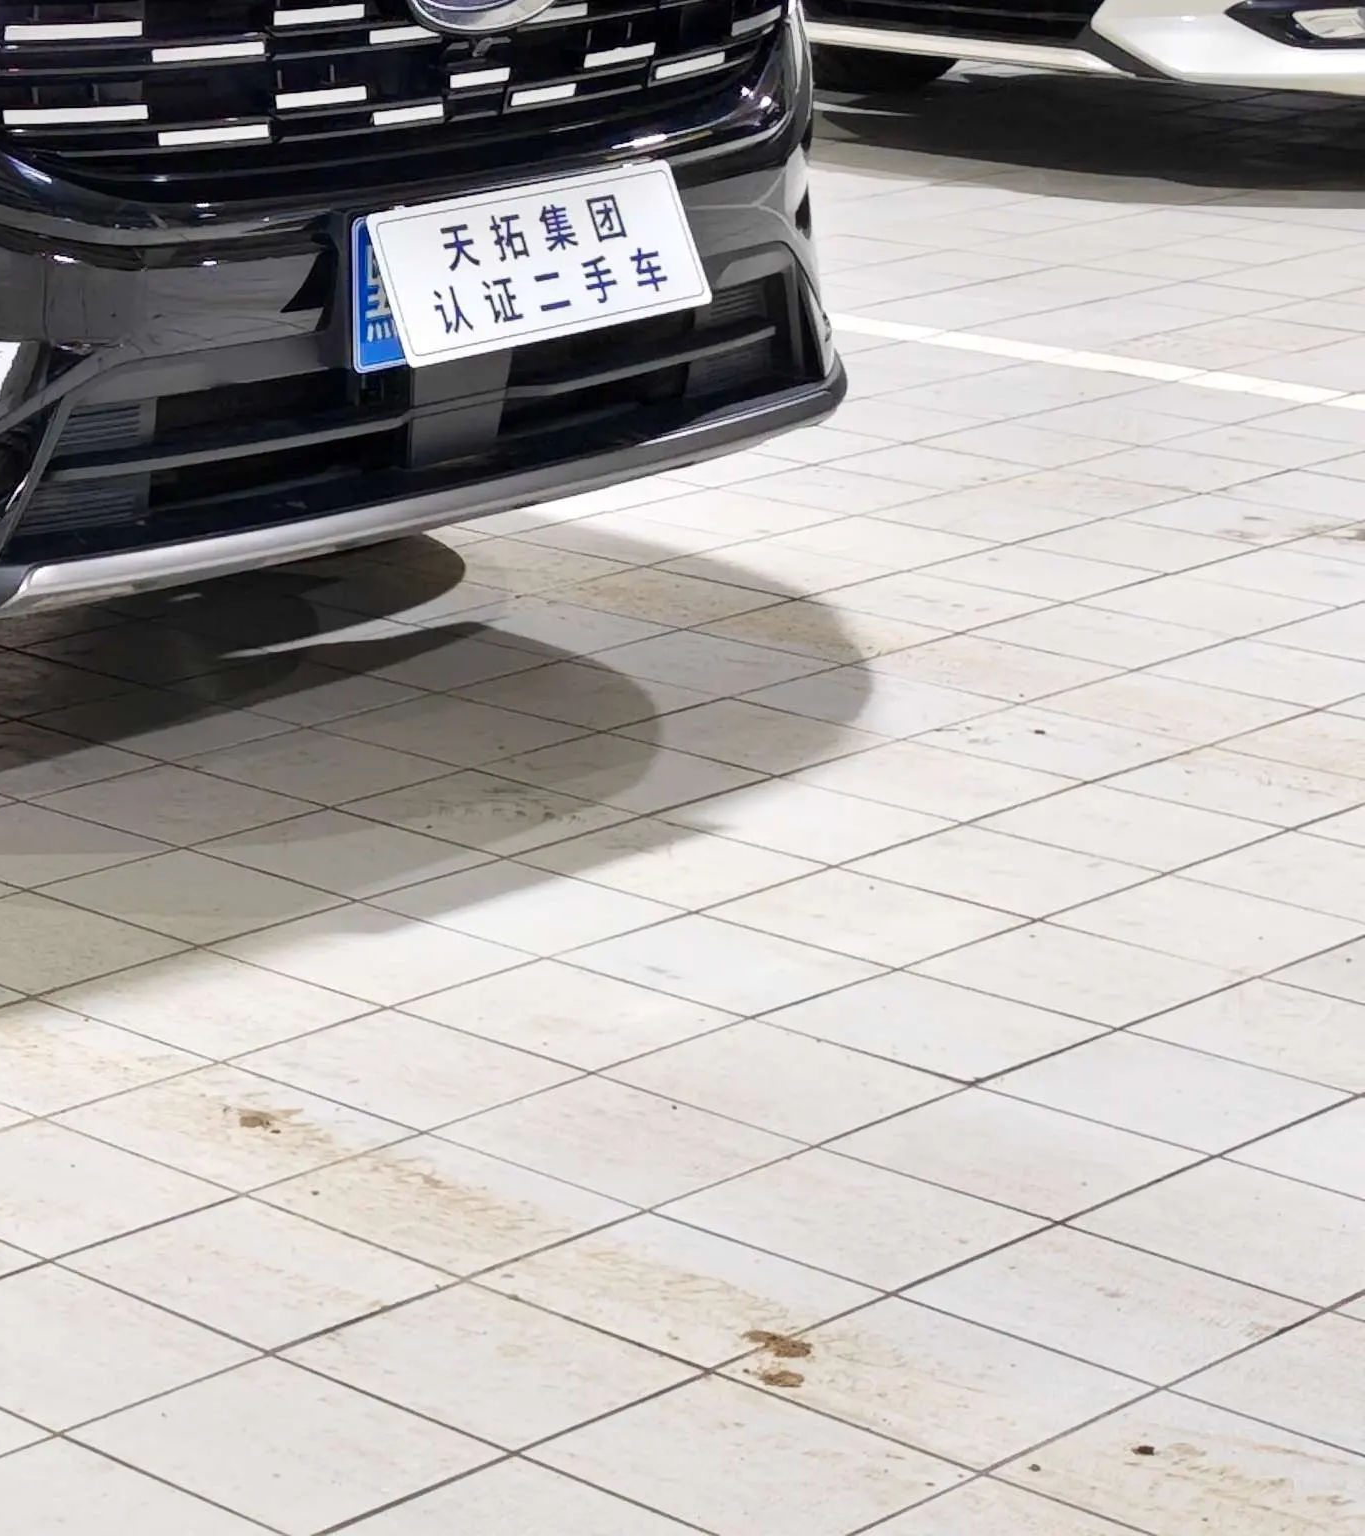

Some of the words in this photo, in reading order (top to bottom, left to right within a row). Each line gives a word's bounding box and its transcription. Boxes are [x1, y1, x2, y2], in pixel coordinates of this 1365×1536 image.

[440, 194, 627, 271] 天拓集团
[433, 248, 668, 334] 认证二手车
